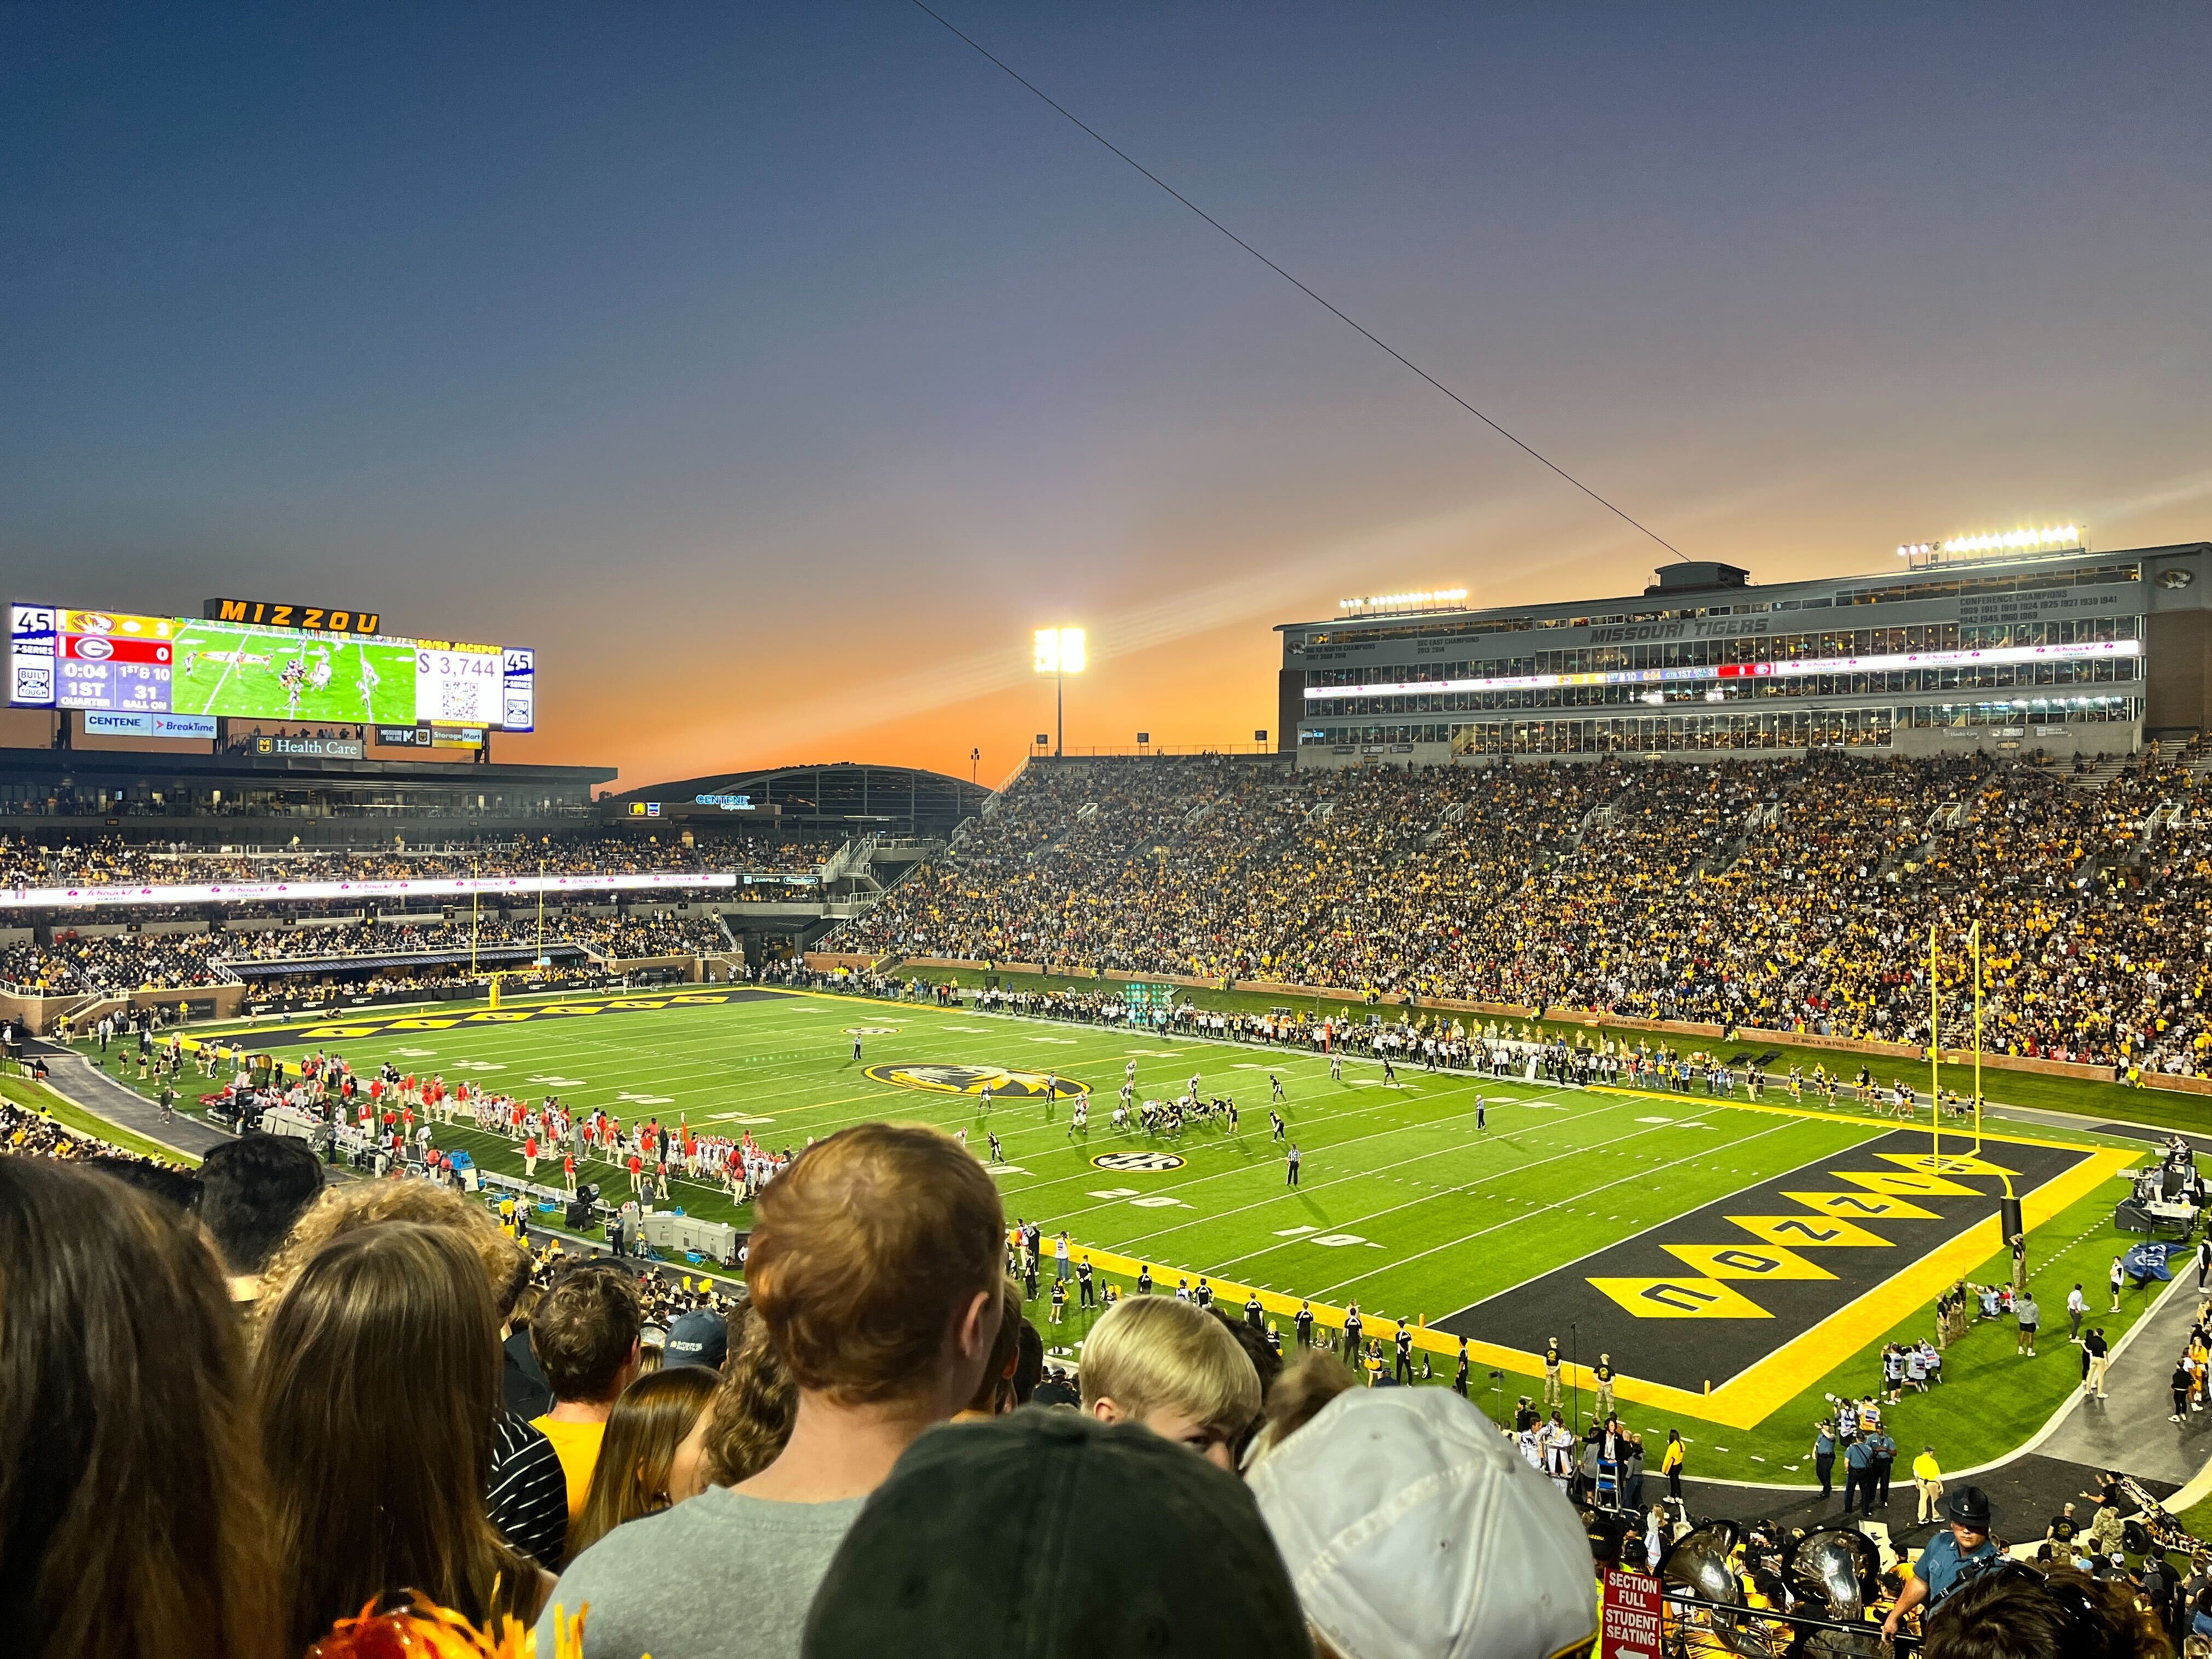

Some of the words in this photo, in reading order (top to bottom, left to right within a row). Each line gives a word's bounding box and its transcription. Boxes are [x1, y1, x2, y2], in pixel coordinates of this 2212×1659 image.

[1960, 592, 2013, 605] CONFERENCE
[2016, 590, 2067, 601] CHAMPIONS
[18, 612, 50, 633] 45
[219, 600, 377, 633] MIZZOU
[1590, 623, 1686, 644] MISSOURI
[1694, 618, 1769, 636] TIGERS
[417, 639, 450, 651] 50/50
[452, 642, 503, 655] JACKPOT
[1444, 636, 1480, 645] CHAMPIONS
[13, 644, 54, 655] F-SERIES
[156, 648, 169, 661] 0
[419, 652, 430, 676] $
[439, 657, 495, 678] 3,744
[507, 653, 529, 671] 45
[21, 670, 47, 679] BUILT
[64, 663, 108, 679] 0:04
[154, 667, 170, 681] 10
[1626, 673, 1637, 681] 10
[1643, 669, 1661, 680] 0:04
[1678, 669, 1690, 678] 1ST
[1707, 667, 1718, 676] 31
[68, 682, 105, 697] 1ST
[134, 685, 156, 700] 31
[60, 697, 110, 707] QUARTER
[123, 700, 149, 709] BALL
[151, 701, 167, 710] ON
[89, 716, 141, 727] CENTENE
[166, 721, 214, 732] BreakTime
[276, 739, 322, 753] Health
[327, 741, 357, 754] Care
[696, 795, 748, 805] CENTENE
[1641, 1156, 1975, 1311] MIZZOU
[1609, 1572, 1657, 1595] SECTION
[1618, 1589, 1646, 1608] FULL
[1605, 1609, 1658, 1631] STUDENT
[1606, 1624, 1656, 1646] SEATING
